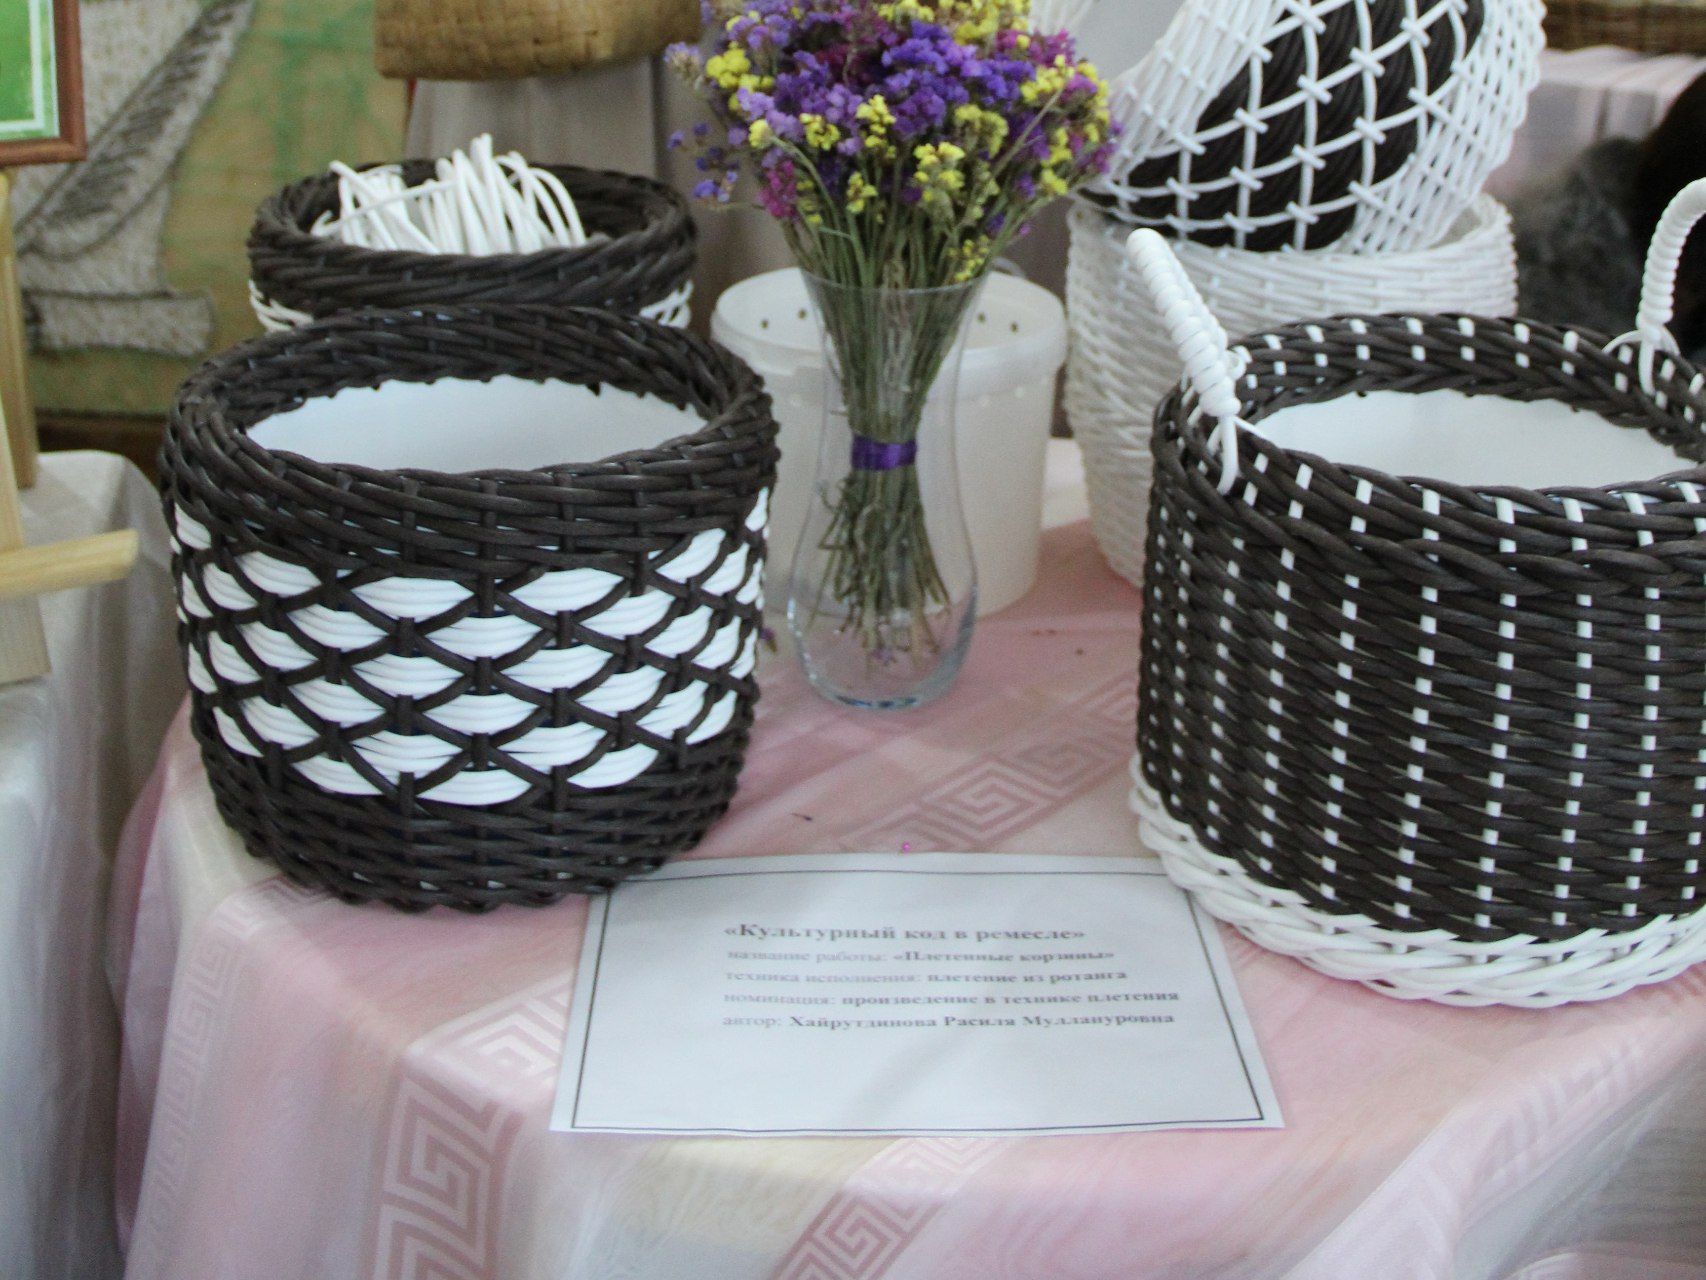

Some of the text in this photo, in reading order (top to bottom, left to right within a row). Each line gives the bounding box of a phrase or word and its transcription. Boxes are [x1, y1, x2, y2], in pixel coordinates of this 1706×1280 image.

[724, 923, 1087, 942] «Культурный код в ремесле»
[984, 995, 997, 1004] в
